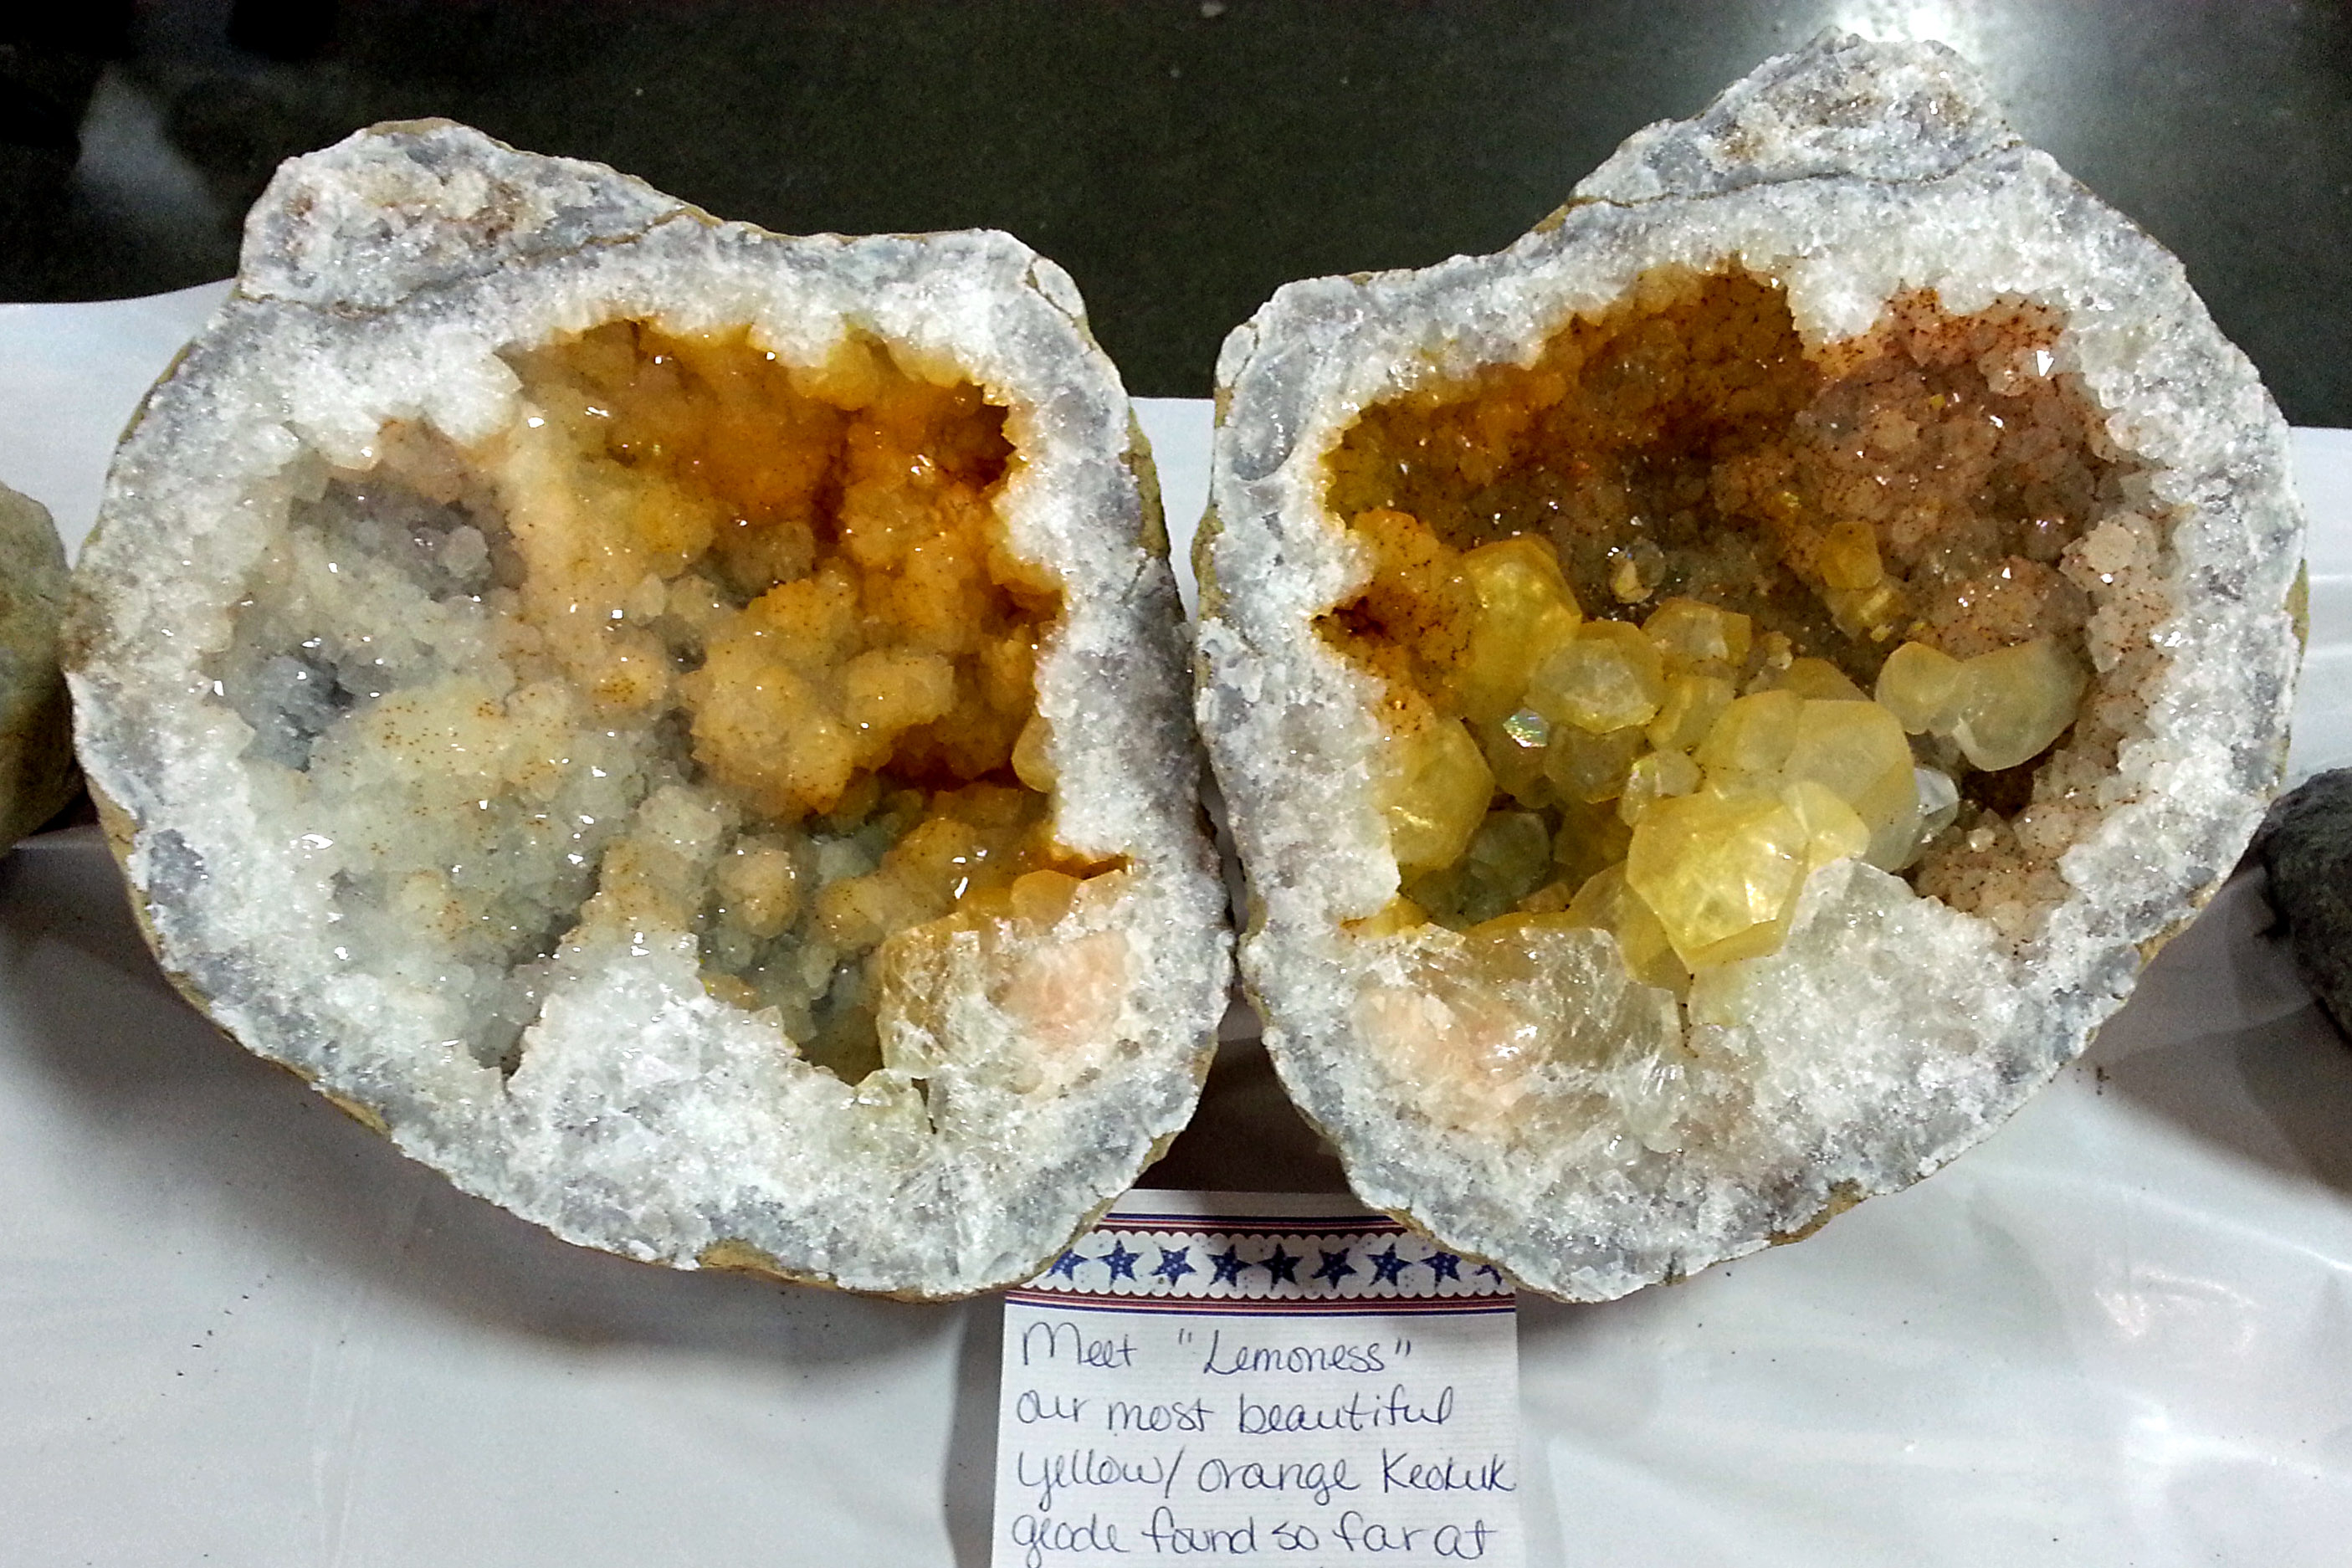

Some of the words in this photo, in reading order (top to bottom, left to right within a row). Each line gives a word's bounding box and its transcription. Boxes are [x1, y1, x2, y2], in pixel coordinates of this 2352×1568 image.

[1022, 1322, 1138, 1368] Meet
[1107, 1401, 1215, 1432] most
[1239, 1383, 1454, 1434] beautiful
[1382, 1448, 1517, 1494] Keokuk
[1012, 1513, 1130, 1568] geode
[1141, 1505, 1258, 1555] found
[1271, 1520, 1319, 1550] so
[1331, 1510, 1429, 1552] far
[1434, 1519, 1499, 1560] at
